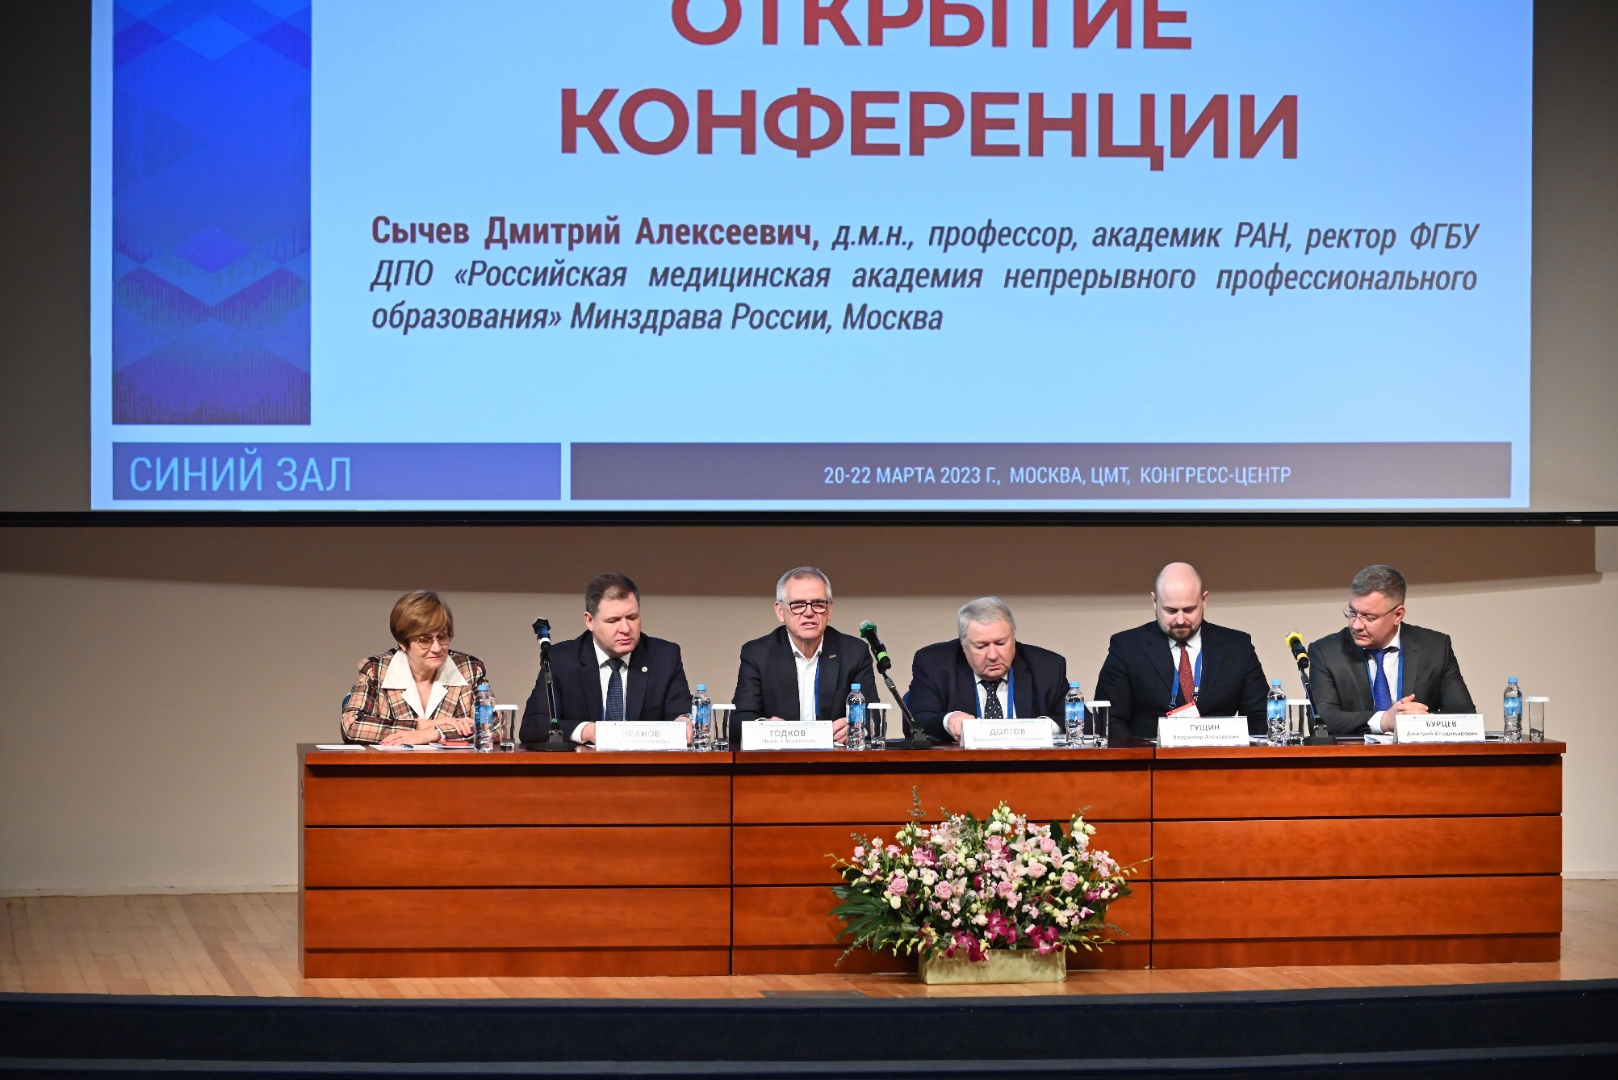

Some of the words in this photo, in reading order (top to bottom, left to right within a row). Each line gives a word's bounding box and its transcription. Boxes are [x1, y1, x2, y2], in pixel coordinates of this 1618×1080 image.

[562, 88, 1297, 171] КОНФЕРЕНЦИИ
[373, 216, 469, 243] Сычев
[484, 215, 620, 251] Дмитрий
[635, 217, 818, 250] Алексеевич,
[831, 226, 914, 250] д.м.н.,
[929, 219, 1078, 254] профессор,
[1092, 227, 1222, 252] академик
[1235, 222, 1291, 252] РАН,
[1305, 229, 1397, 255] ректор
[1410, 222, 1480, 250] ФГБУ
[370, 259, 433, 291] ДПО
[455, 259, 627, 288] «Российская
[649, 266, 831, 292] медицинская
[852, 268, 983, 293] академия
[1004, 268, 1196, 295] непрерывного
[1216, 262, 1478, 296] профессионального
[372, 300, 561, 335] образования»
[570, 302, 722, 336] Минздрава
[731, 303, 832, 334] России,
[843, 303, 943, 330] Москва
[130, 447, 263, 492] СИНИЙ
[276, 457, 352, 492] ЗАЛ
[824, 467, 871, 484] 20-22
[876, 467, 936, 484] МАРТА
[940, 467, 981, 484] 2023
[986, 467, 1001, 486] Г.,
[1010, 467, 1086, 487] МОСКВА,
[1091, 467, 1131, 487] ЦМТ,
[1140, 467, 1292, 487] КОНГРЕСС-ЦЕНТР
[769, 729, 807, 738] ГОДКОВ
[989, 728, 1026, 736] ДОЛГОВ
[1190, 724, 1220, 732] ГУЩИН
[1425, 720, 1458, 728] БУРЦЕВ
